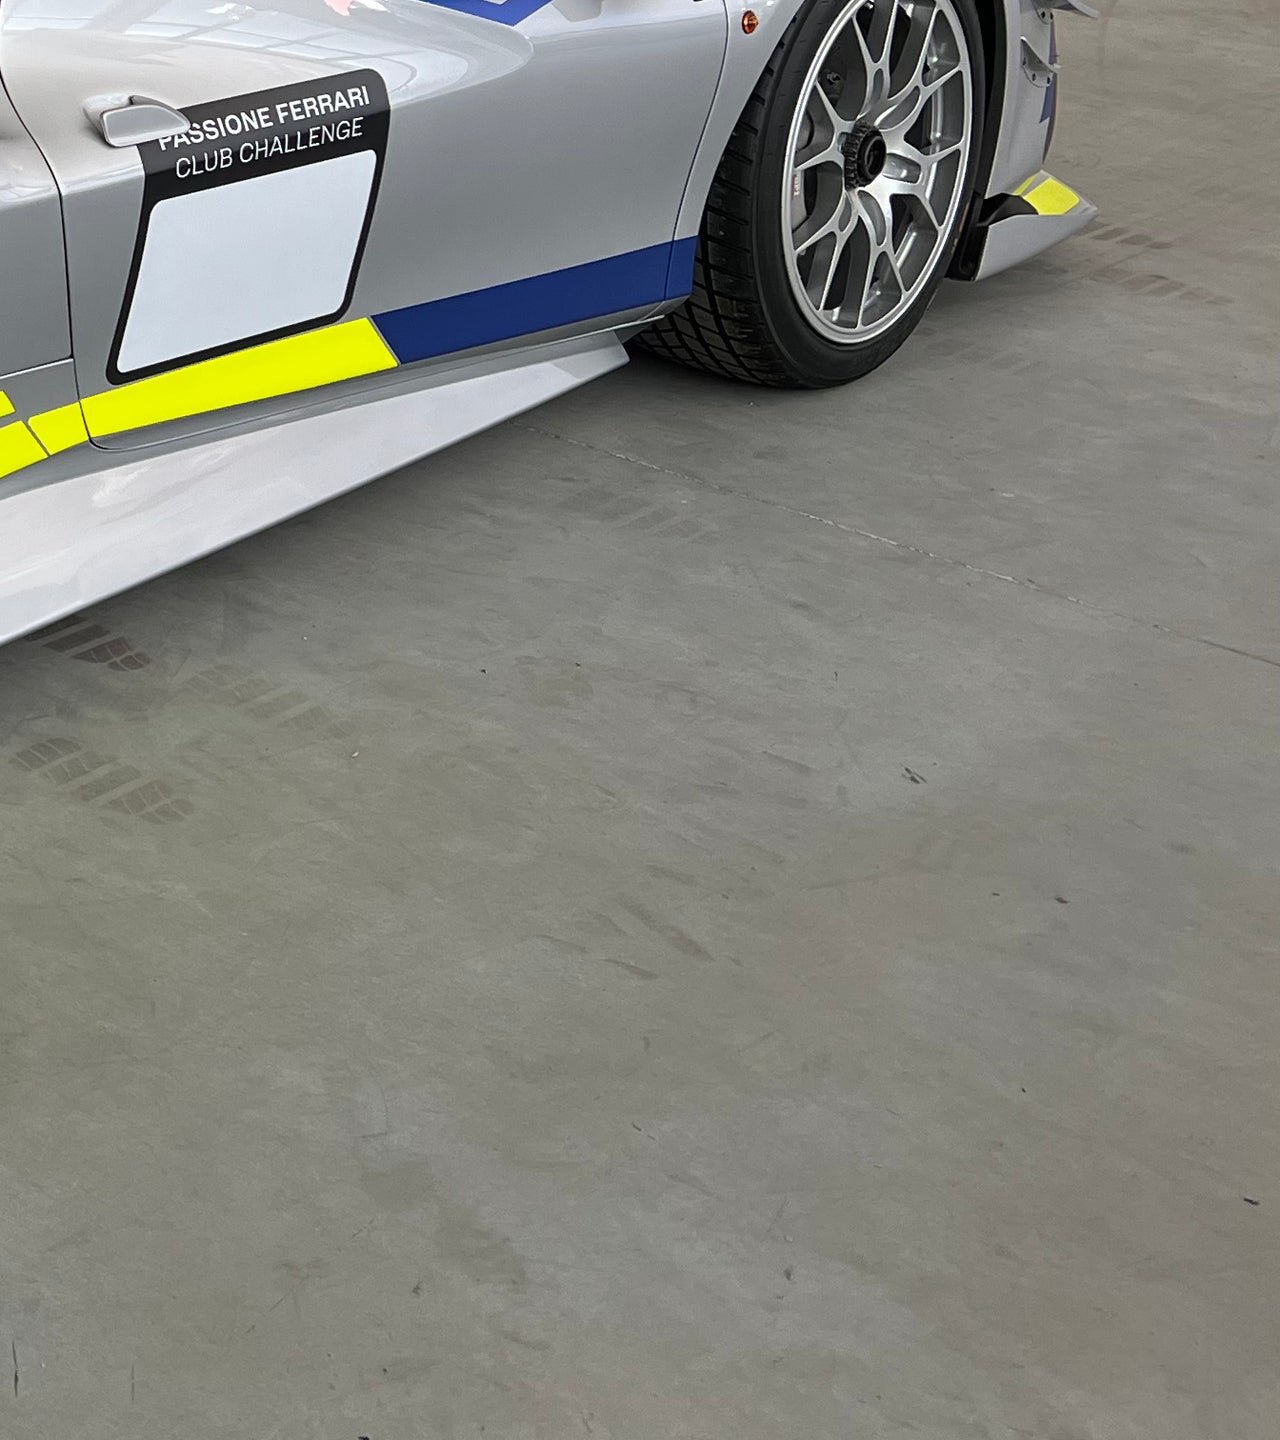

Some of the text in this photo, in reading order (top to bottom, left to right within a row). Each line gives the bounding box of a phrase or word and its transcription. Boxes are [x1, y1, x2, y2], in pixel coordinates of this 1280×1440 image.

[158, 85, 370, 151] PASSIONE FERRARI
[175, 117, 364, 179] CLUB CHALLENGE
